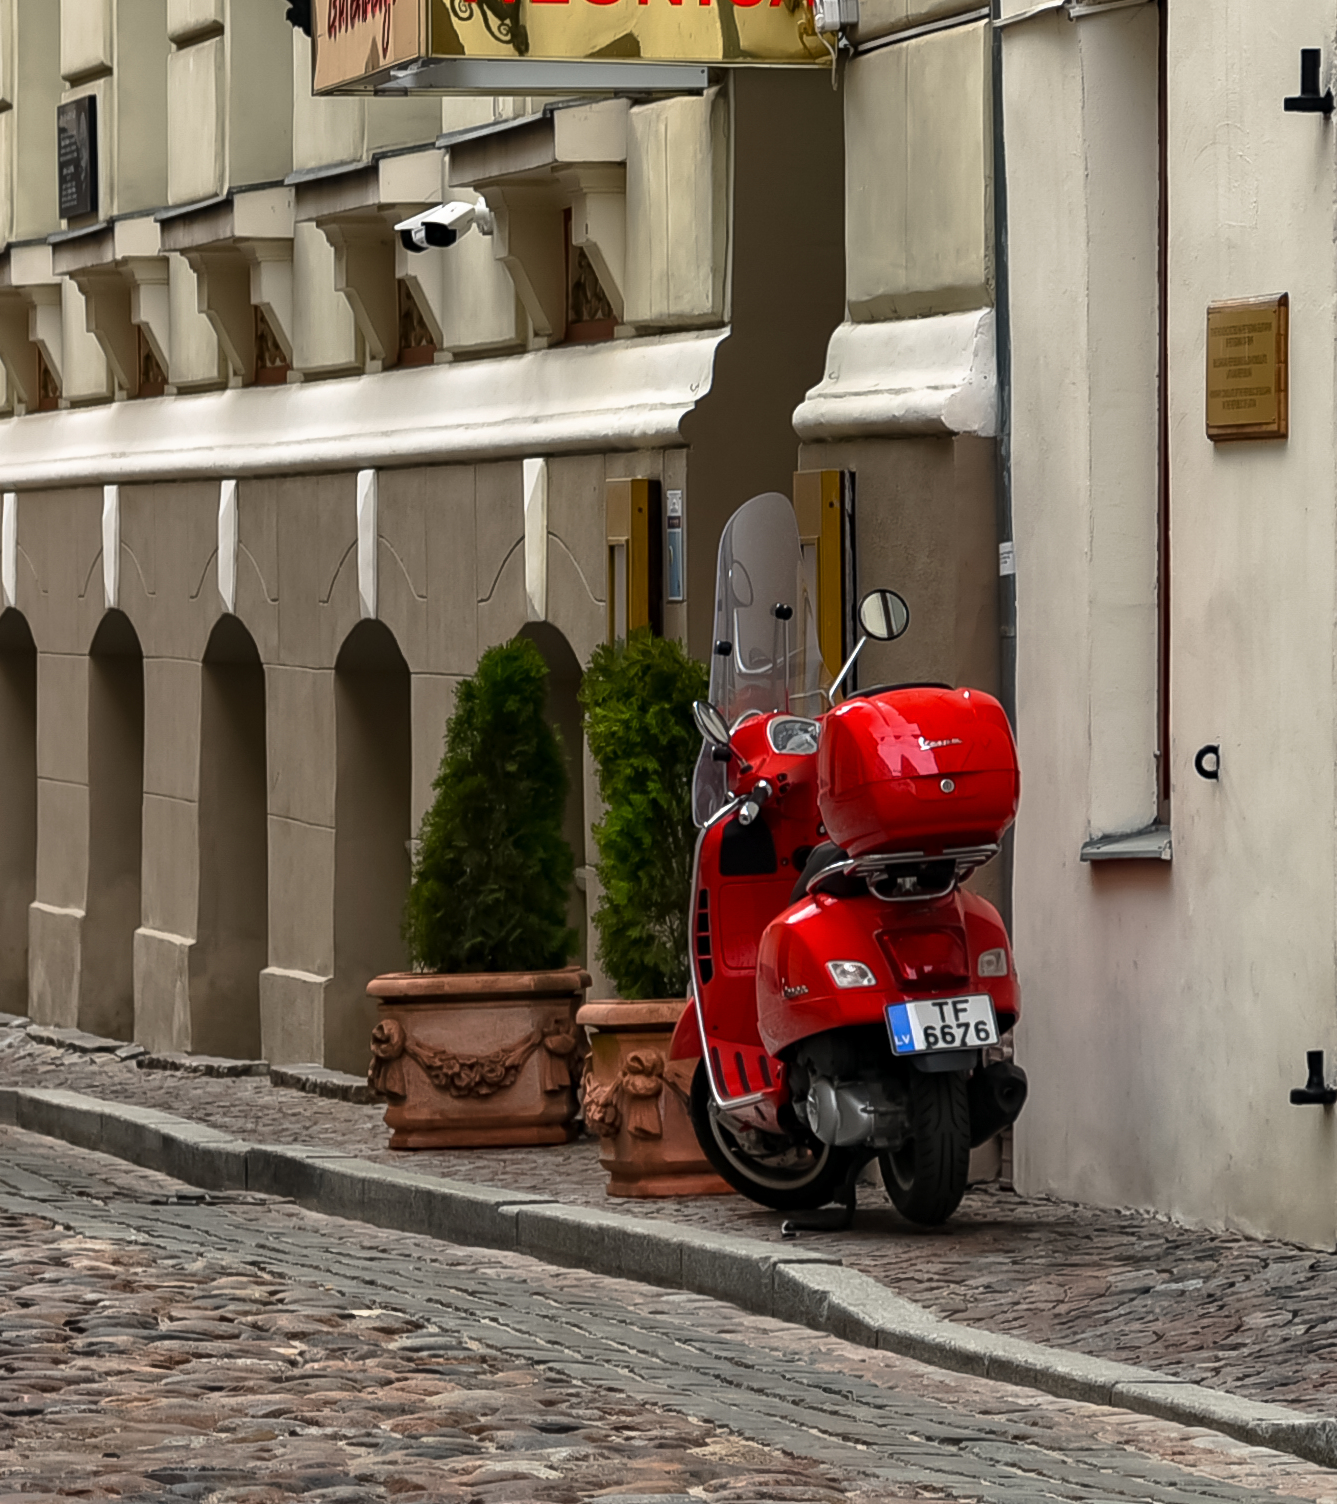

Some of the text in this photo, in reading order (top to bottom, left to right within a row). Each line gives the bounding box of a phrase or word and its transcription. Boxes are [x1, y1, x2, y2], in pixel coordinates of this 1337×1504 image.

[931, 999, 969, 1023] TF
[894, 1034, 910, 1046] LV
[923, 1020, 990, 1048] 6676
